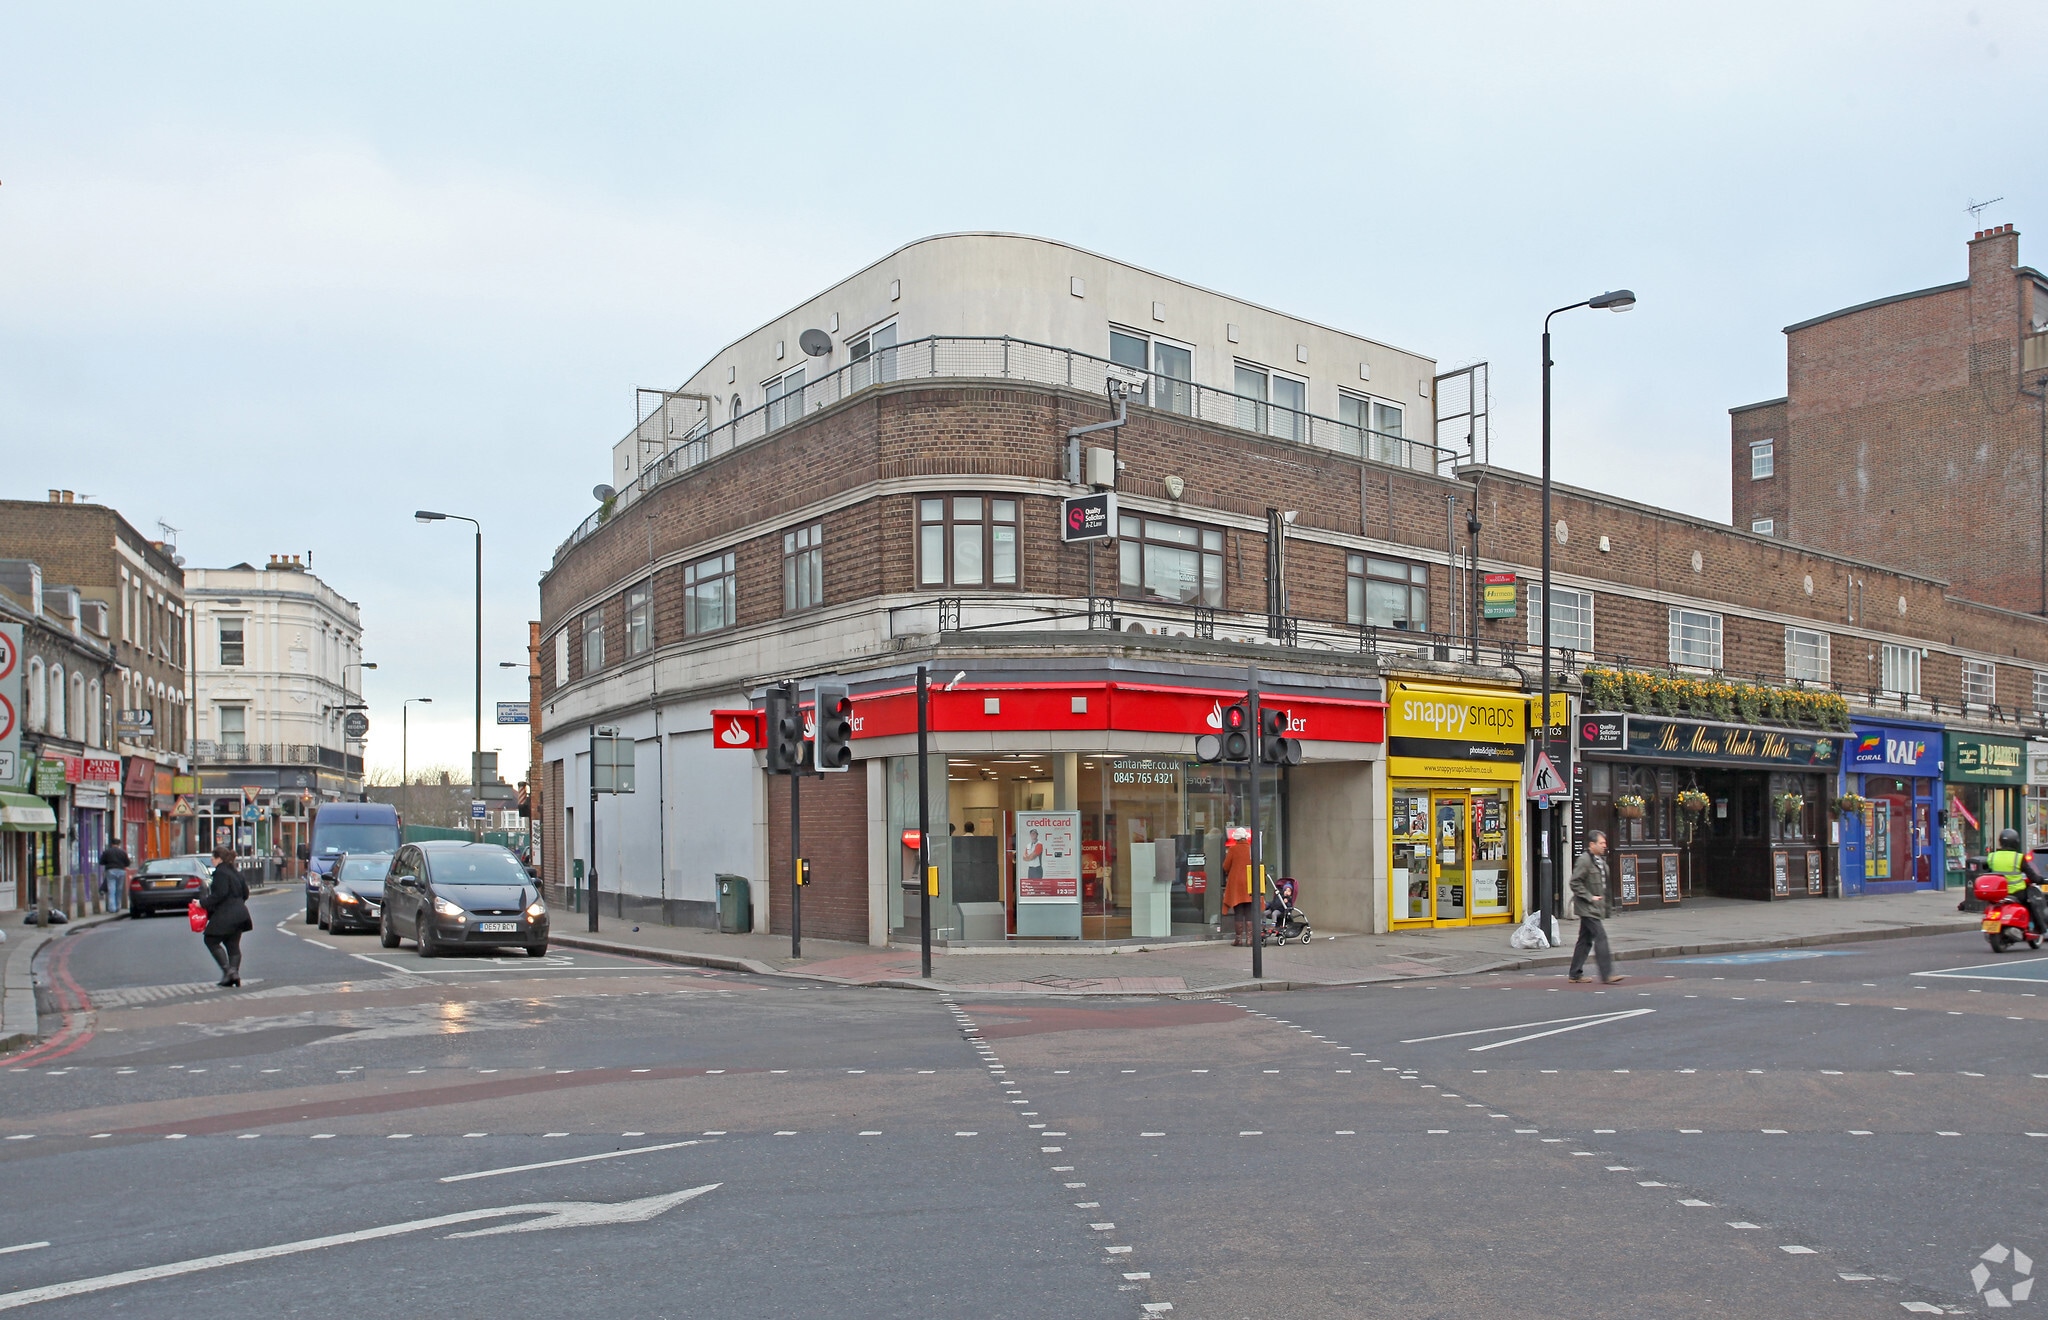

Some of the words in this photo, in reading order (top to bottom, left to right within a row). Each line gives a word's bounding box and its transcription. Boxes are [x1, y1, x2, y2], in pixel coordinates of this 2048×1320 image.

[1534, 728, 1561, 736] PHTOS
[1654, 724, 1679, 751] The
[1682, 726, 1718, 754] Moon
[1722, 729, 1756, 756] Under
[1761, 732, 1790, 758] Water
[1887, 739, 1916, 765] RAL
[1114, 760, 1180, 770] santander.co.uk
[1114, 772, 1134, 783] 0845
[1137, 773, 1152, 784] 765
[1154, 774, 1173, 784] 4321
[1026, 818, 1051, 827] credit
[1053, 818, 1071, 826] card
